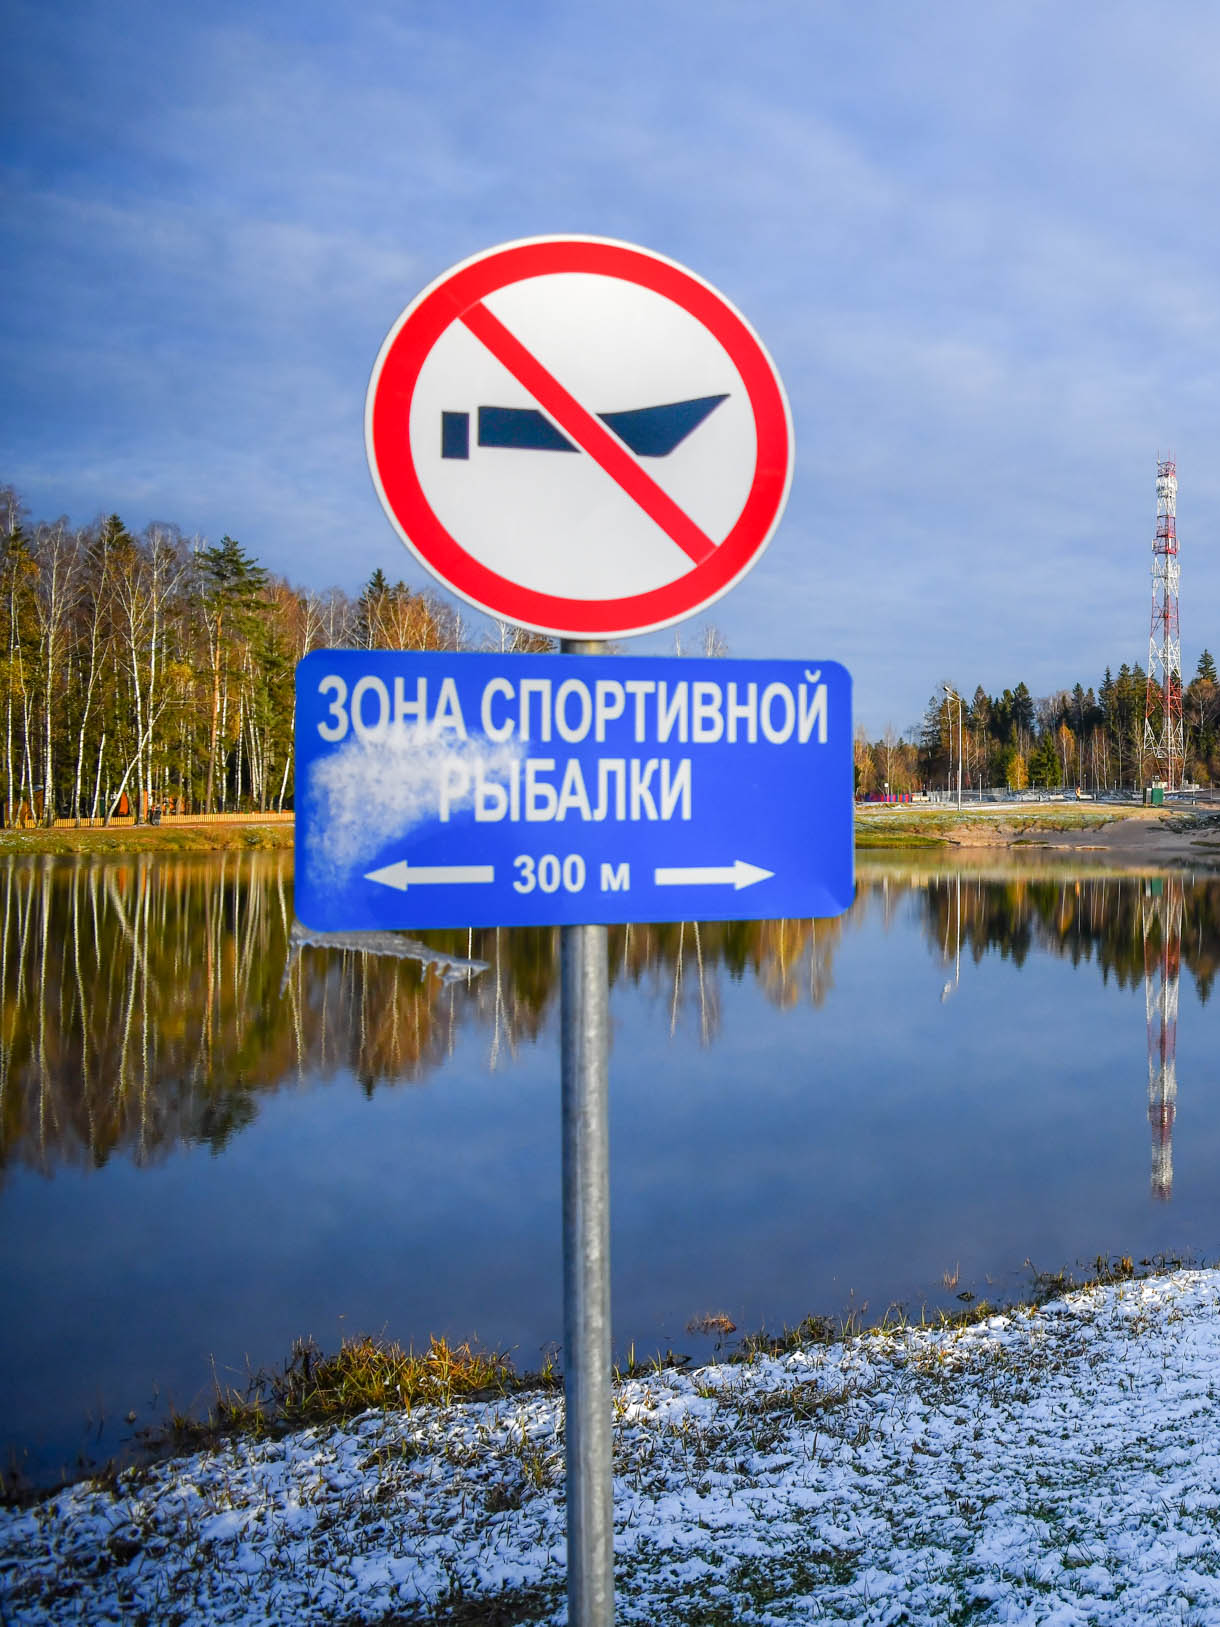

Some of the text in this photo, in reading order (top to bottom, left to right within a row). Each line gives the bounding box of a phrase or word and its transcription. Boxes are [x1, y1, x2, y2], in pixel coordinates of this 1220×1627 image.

[317, 669, 828, 744] ЗОНА СПОРТИВНОЙ
[440, 758, 692, 822] РЫБАЛКИ
[513, 854, 630, 894] 300 м
